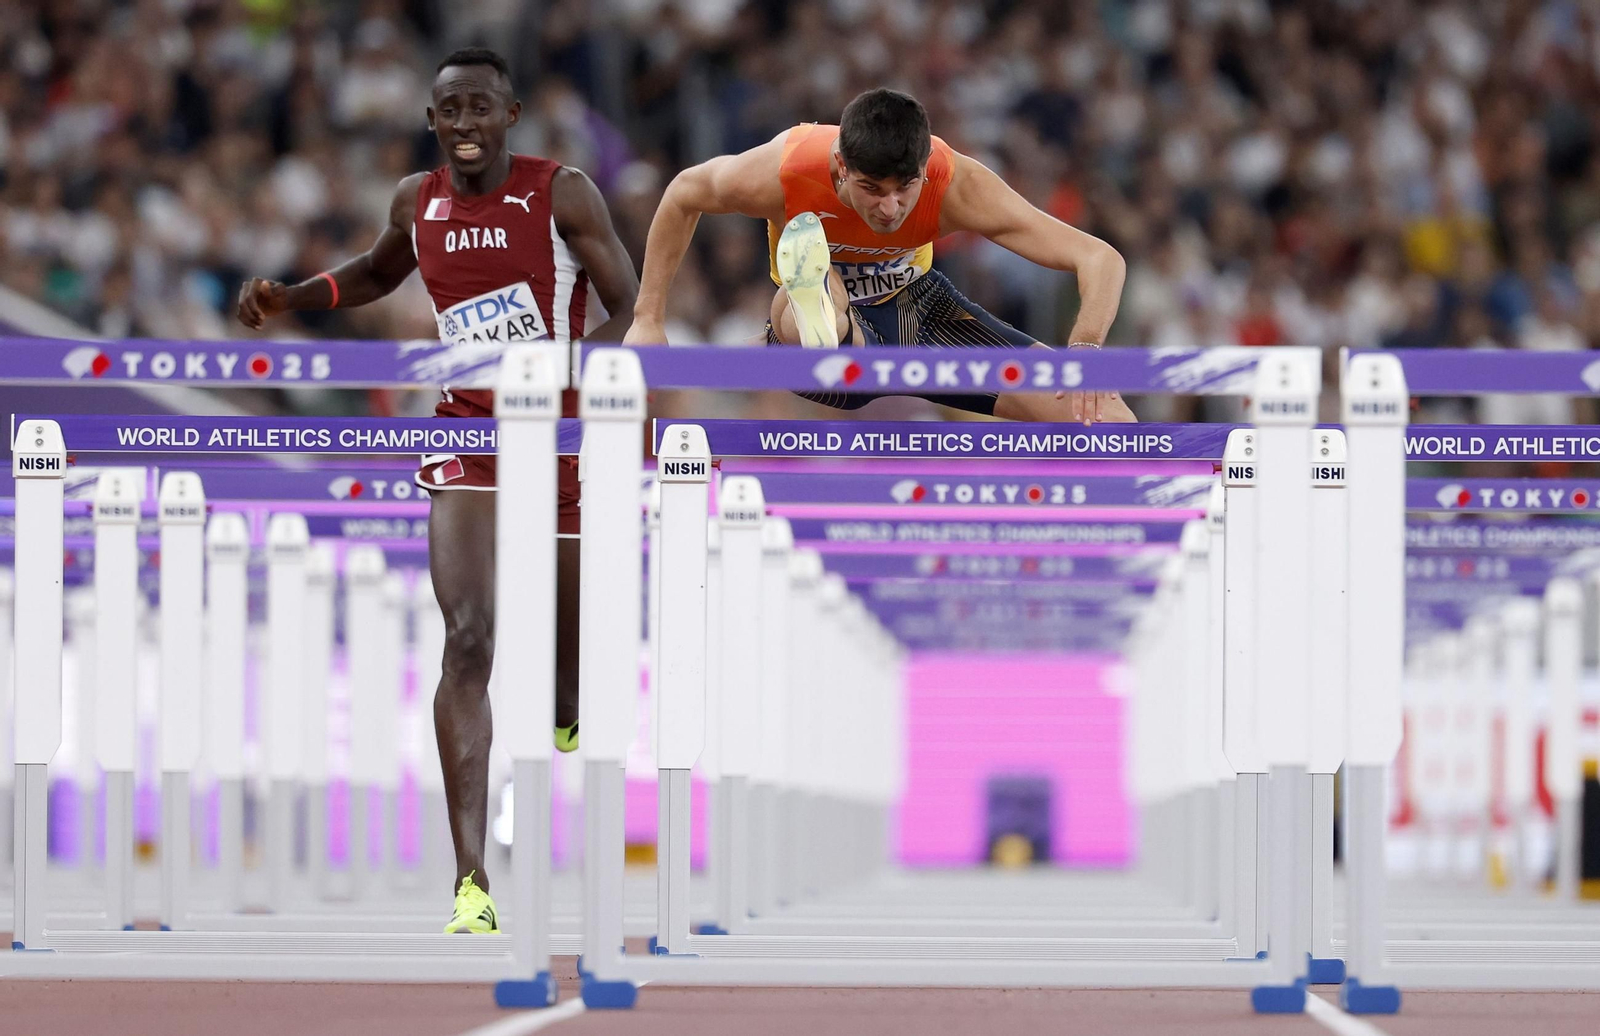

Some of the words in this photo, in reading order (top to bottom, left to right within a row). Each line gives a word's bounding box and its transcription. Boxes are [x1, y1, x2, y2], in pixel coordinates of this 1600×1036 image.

[445, 227, 508, 253] QATAR
[843, 267, 915, 298] RTINEZ
[452, 287, 527, 329] TDK
[116, 427, 200, 446] WORLD
[207, 427, 331, 447] ATHLETICS
[759, 432, 842, 451] WORLD
[849, 433, 974, 452] ATHLETICS
[981, 434, 1173, 453] CHAMPIONSHIPS
[1403, 436, 1486, 455] WORLD
[1493, 437, 1600, 456] ATHLETIC
[18, 457, 60, 470] NISHI
[664, 462, 705, 475] NISHI
[1228, 466, 1257, 479] NIS
